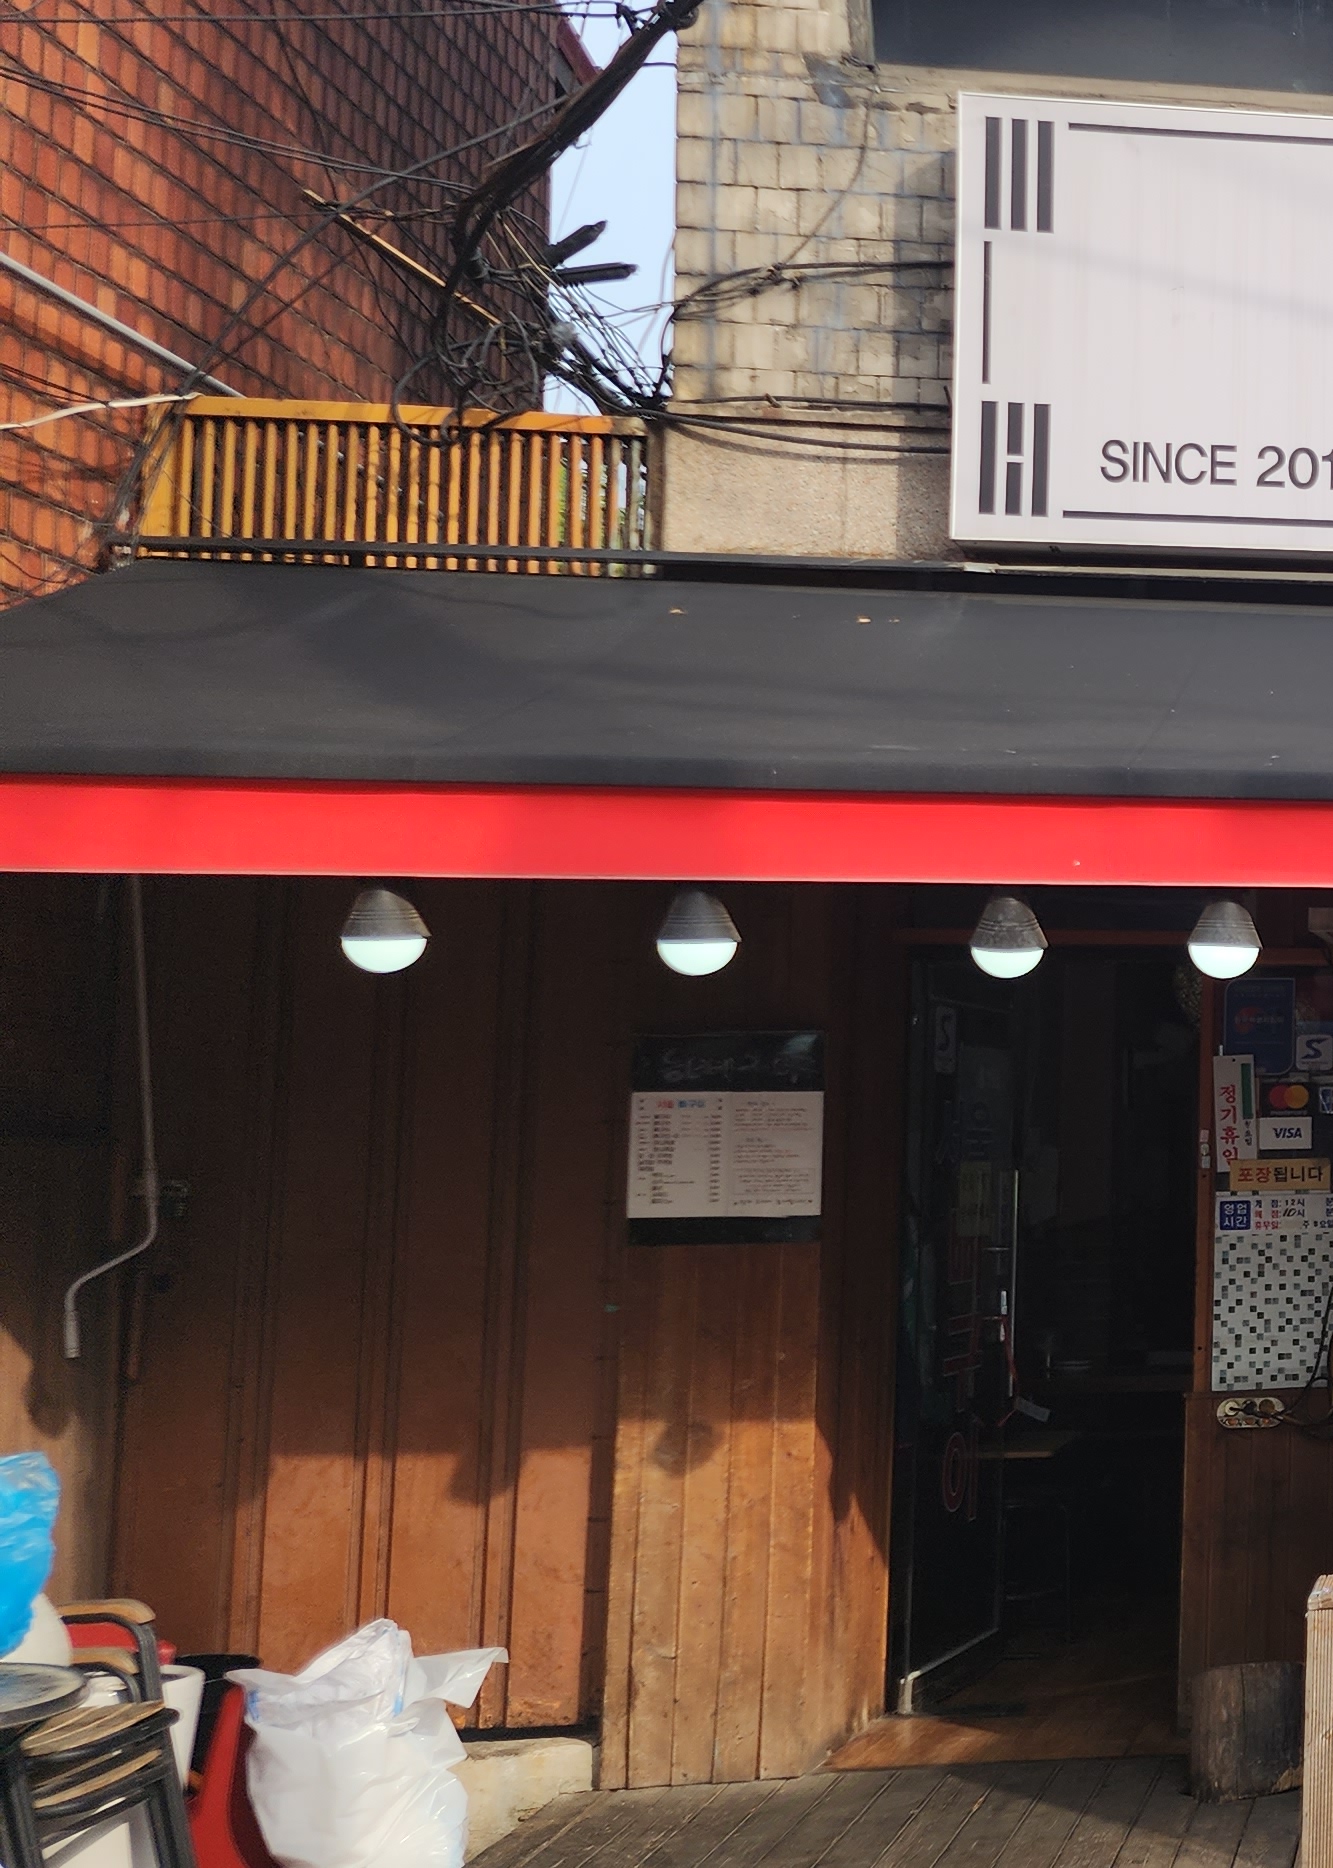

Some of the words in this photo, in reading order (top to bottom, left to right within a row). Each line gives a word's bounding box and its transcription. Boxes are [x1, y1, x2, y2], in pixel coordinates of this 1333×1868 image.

[1100, 439, 1237, 486] SINCE
[1219, 1084, 1240, 1165] 정기휴일
[1273, 1127, 1303, 1139] VISA
[1237, 1166, 1323, 1183] 포장됩니다
[1224, 1203, 1248, 1215] 영업
[1223, 1216, 1247, 1228] 시간
